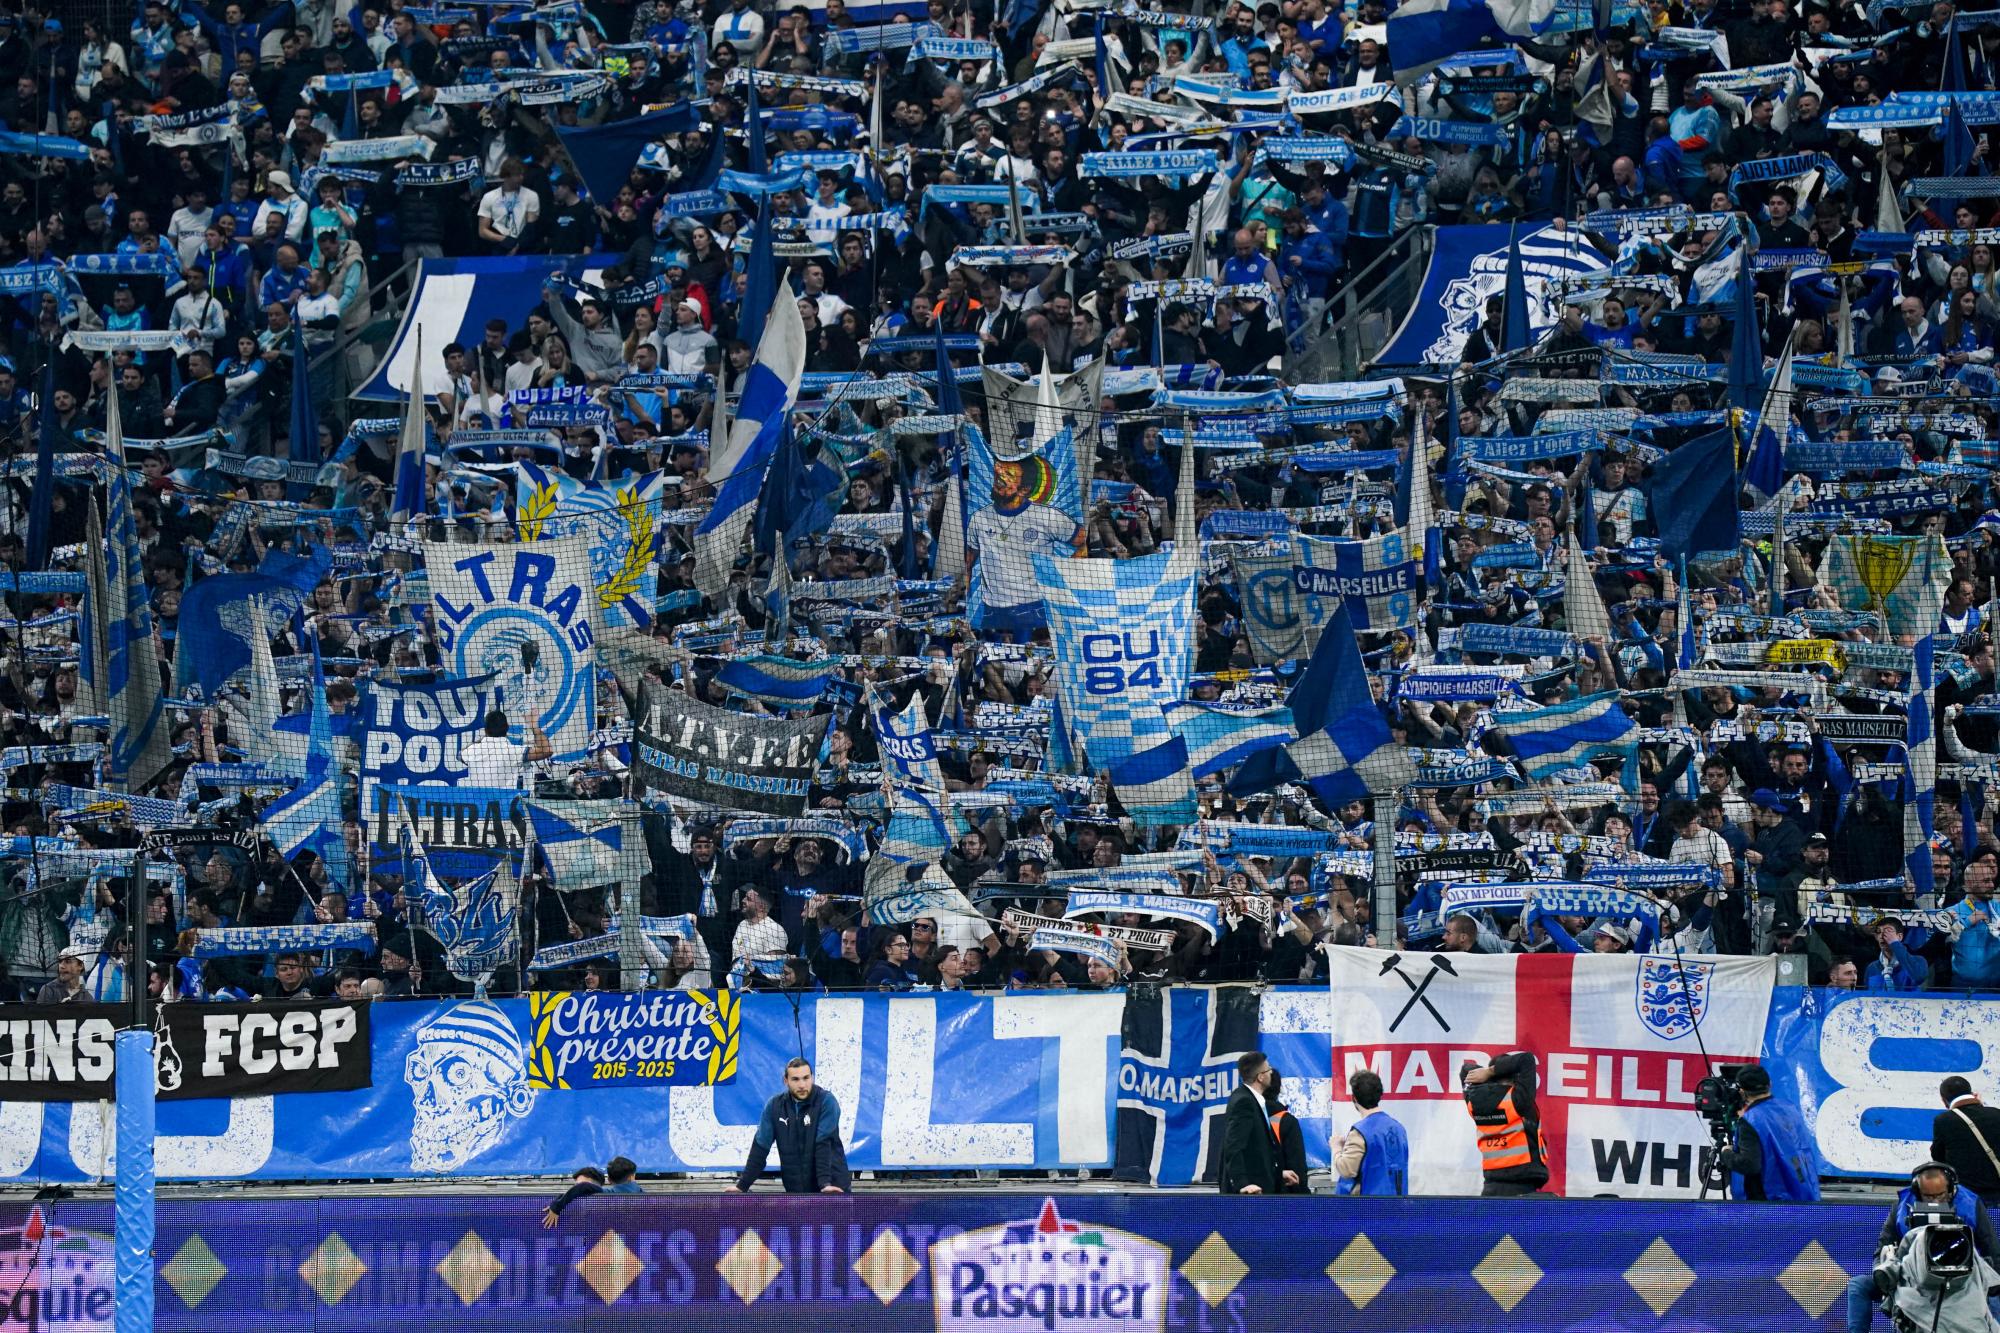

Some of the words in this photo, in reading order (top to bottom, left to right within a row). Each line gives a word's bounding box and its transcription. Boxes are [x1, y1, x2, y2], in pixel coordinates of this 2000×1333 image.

[1291, 94, 1332, 107] DROIT
[1360, 84, 1387, 100] BUT
[1410, 119, 1441, 138] 120
[1456, 132, 1489, 142] MARSEILLE
[1291, 145, 1343, 155] MARSEILLE
[1369, 145, 1379, 153] DE
[1382, 147, 1424, 167] MARSEILLE
[1107, 156, 1154, 172] ALLEZ
[1158, 156, 1197, 170] L'OM
[678, 199, 716, 214] ALLEZ
[1796, 374, 1843, 385] MARSEILLE
[529, 409, 570, 421] ALLEZ
[575, 409, 607, 420] L'OM
[534, 432, 547, 442] 84
[1485, 442, 1527, 457] Allez
[1381, 537, 1404, 566] 8
[1313, 568, 1409, 596] MARSEILLE
[434, 550, 595, 653] ULTRAS
[1387, 594, 1411, 628] 9
[1082, 629, 1161, 664] CU
[1085, 660, 1162, 695] 84
[1400, 679, 1453, 696] OLYMPIQUE
[1457, 676, 1509, 694] MARSEILLE
[638, 741, 700, 779] ULTRAS
[1452, 763, 1491, 780] L'OM!
[177, 833, 207, 845] pour
[212, 832, 231, 843] les
[1430, 856, 1464, 873] pour
[1467, 853, 1490, 866] les
[1447, 887, 1521, 903] OLYMPIQUE
[1542, 886, 1639, 915] ULTRAS
[1074, 893, 1122, 906] ULTRAS
[1142, 896, 1212, 920] MARSEILLE
[1107, 927, 1124, 942] ST.
[1126, 930, 1163, 945] PAULI
[552, 995, 719, 1037] Christine
[202, 1006, 357, 1077] FCSP
[556, 1027, 713, 1078] présente
[1486, 1137, 1508, 1148] 023
[951, 1262, 1150, 1331] Pasquier
